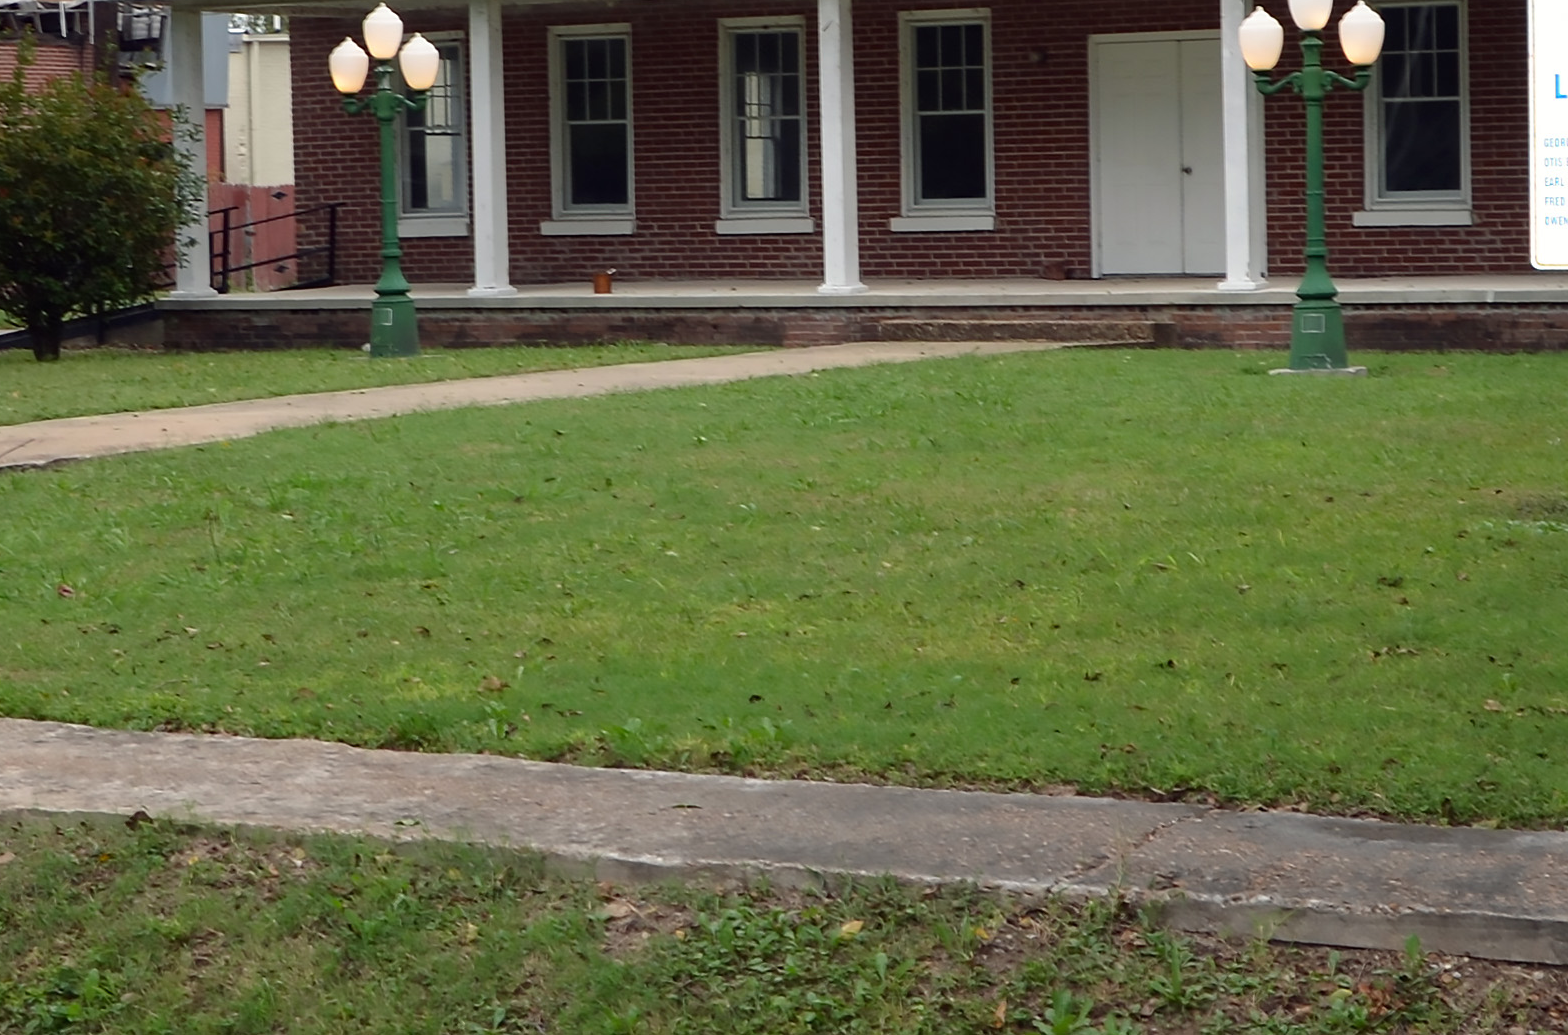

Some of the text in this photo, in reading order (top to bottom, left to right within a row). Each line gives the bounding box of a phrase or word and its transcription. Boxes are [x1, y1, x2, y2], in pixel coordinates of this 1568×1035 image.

[1544, 157, 1563, 167] OTIS
[1545, 177, 1564, 187] EARL
[1545, 197, 1565, 206] FRED
[1545, 216, 1568, 225] OWEN
